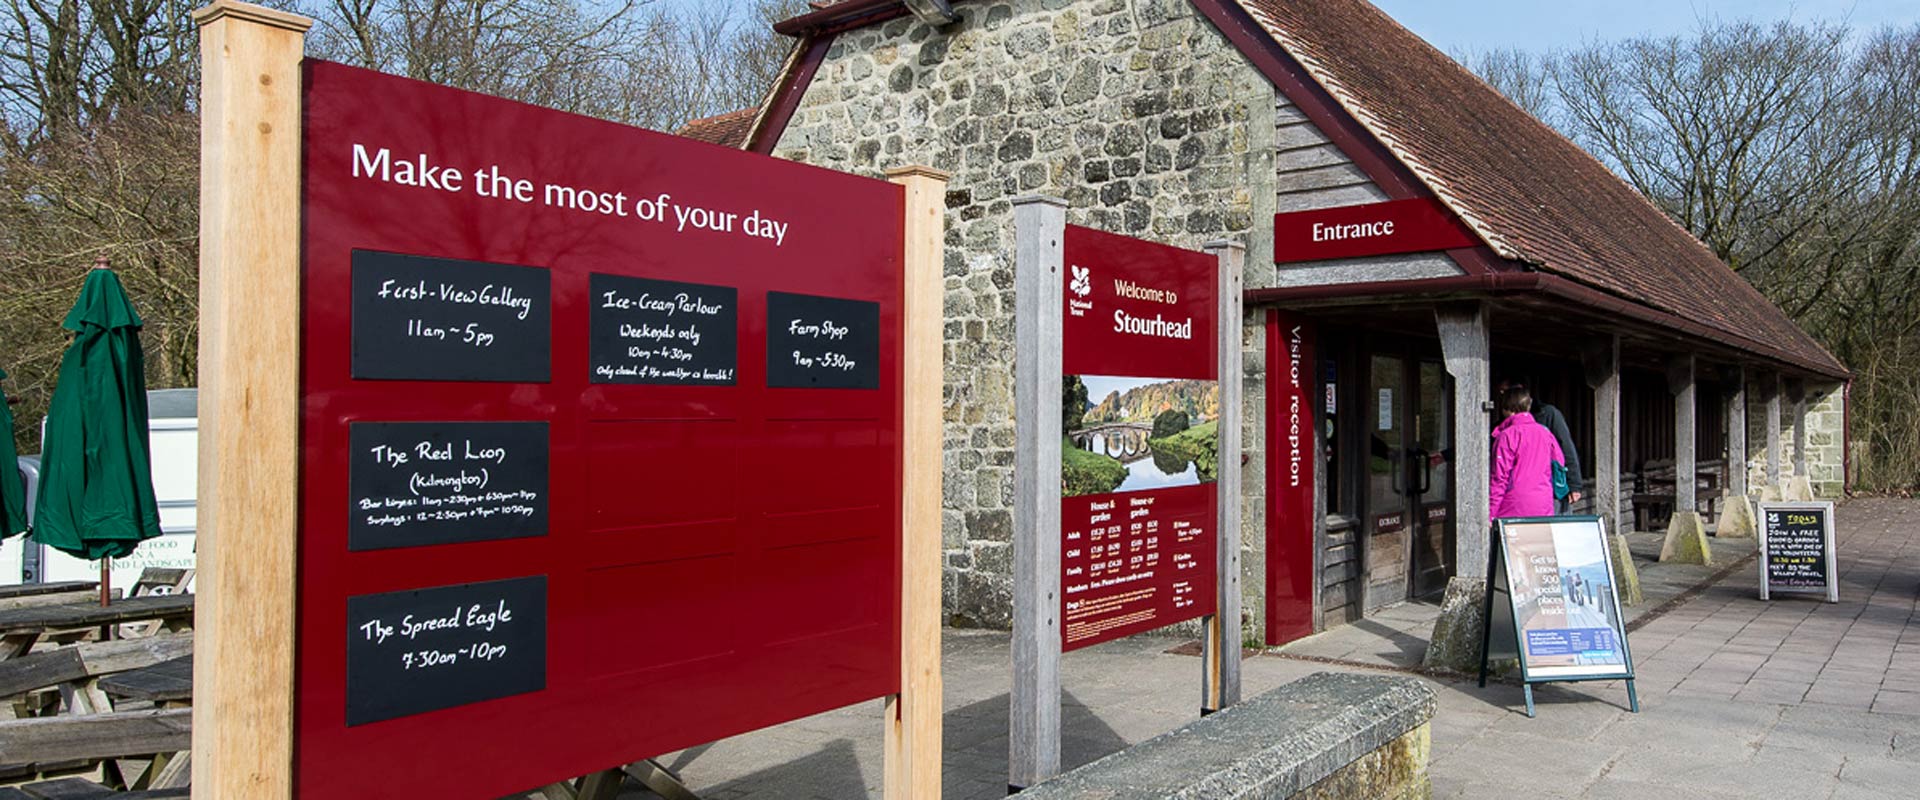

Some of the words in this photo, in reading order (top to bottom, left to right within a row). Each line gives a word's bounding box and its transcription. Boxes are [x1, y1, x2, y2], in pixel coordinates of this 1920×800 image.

[351, 144, 463, 191] Make
[474, 166, 534, 202] the
[545, 184, 627, 217] most
[636, 194, 671, 222] of
[674, 202, 737, 232] your
[743, 210, 788, 245] day
[1312, 220, 1394, 242] Entrance
[479, 284, 531, 320] Gallery
[1114, 279, 1164, 303] Welcome
[1166, 290, 1177, 304] to
[602, 290, 675, 316] Ice-Cream
[675, 293, 722, 314] Parlour
[1070, 299, 1092, 310] National
[1070, 307, 1084, 317] Trust
[408, 319, 445, 340] 11am
[463, 323, 494, 346] 5pm
[620, 324, 675, 342] Weekends
[678, 324, 700, 346] only
[788, 319, 819, 338] Farm
[821, 320, 849, 340] Shop
[1114, 309, 1192, 339] Stourhead
[793, 350, 813, 368] 9am
[1291, 325, 1301, 388] Visitor
[596, 365, 614, 379] Only
[1289, 394, 1301, 487] reception
[371, 445, 408, 468] The
[415, 441, 452, 461] Red
[465, 440, 506, 463] Lion
[359, 498, 382, 509] Bar
[1787, 514, 1817, 524] TODAY
[149, 541, 178, 549] FOOD
[1534, 565, 1557, 573] know
[1542, 575, 1559, 584] 500
[360, 620, 395, 643] The
[400, 607, 460, 639] Spread
[466, 599, 512, 632] Eagle
[470, 642, 506, 662] 10pm
